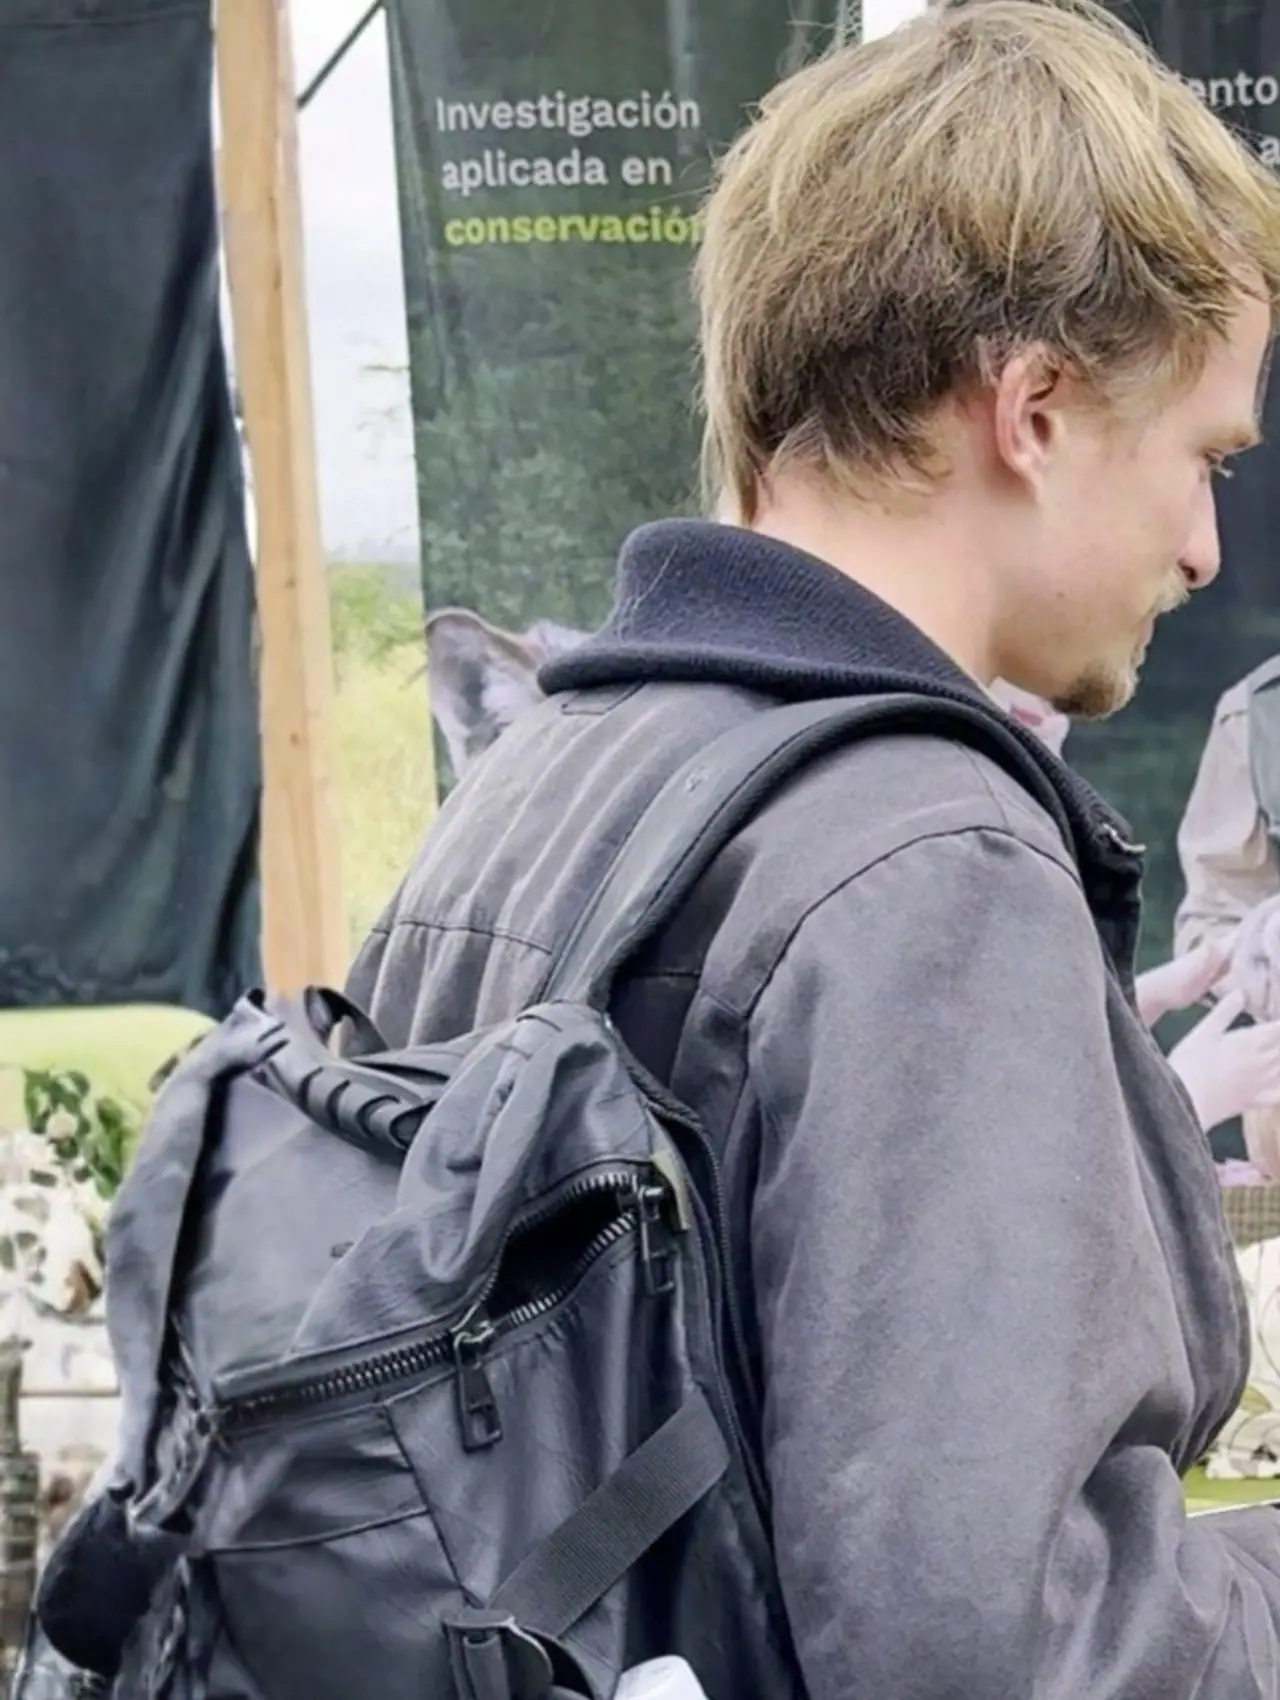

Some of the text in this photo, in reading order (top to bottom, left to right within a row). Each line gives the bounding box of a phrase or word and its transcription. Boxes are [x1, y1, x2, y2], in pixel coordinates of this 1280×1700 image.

[436, 88, 701, 136] Investigación
[441, 147, 672, 196] aplicada en
